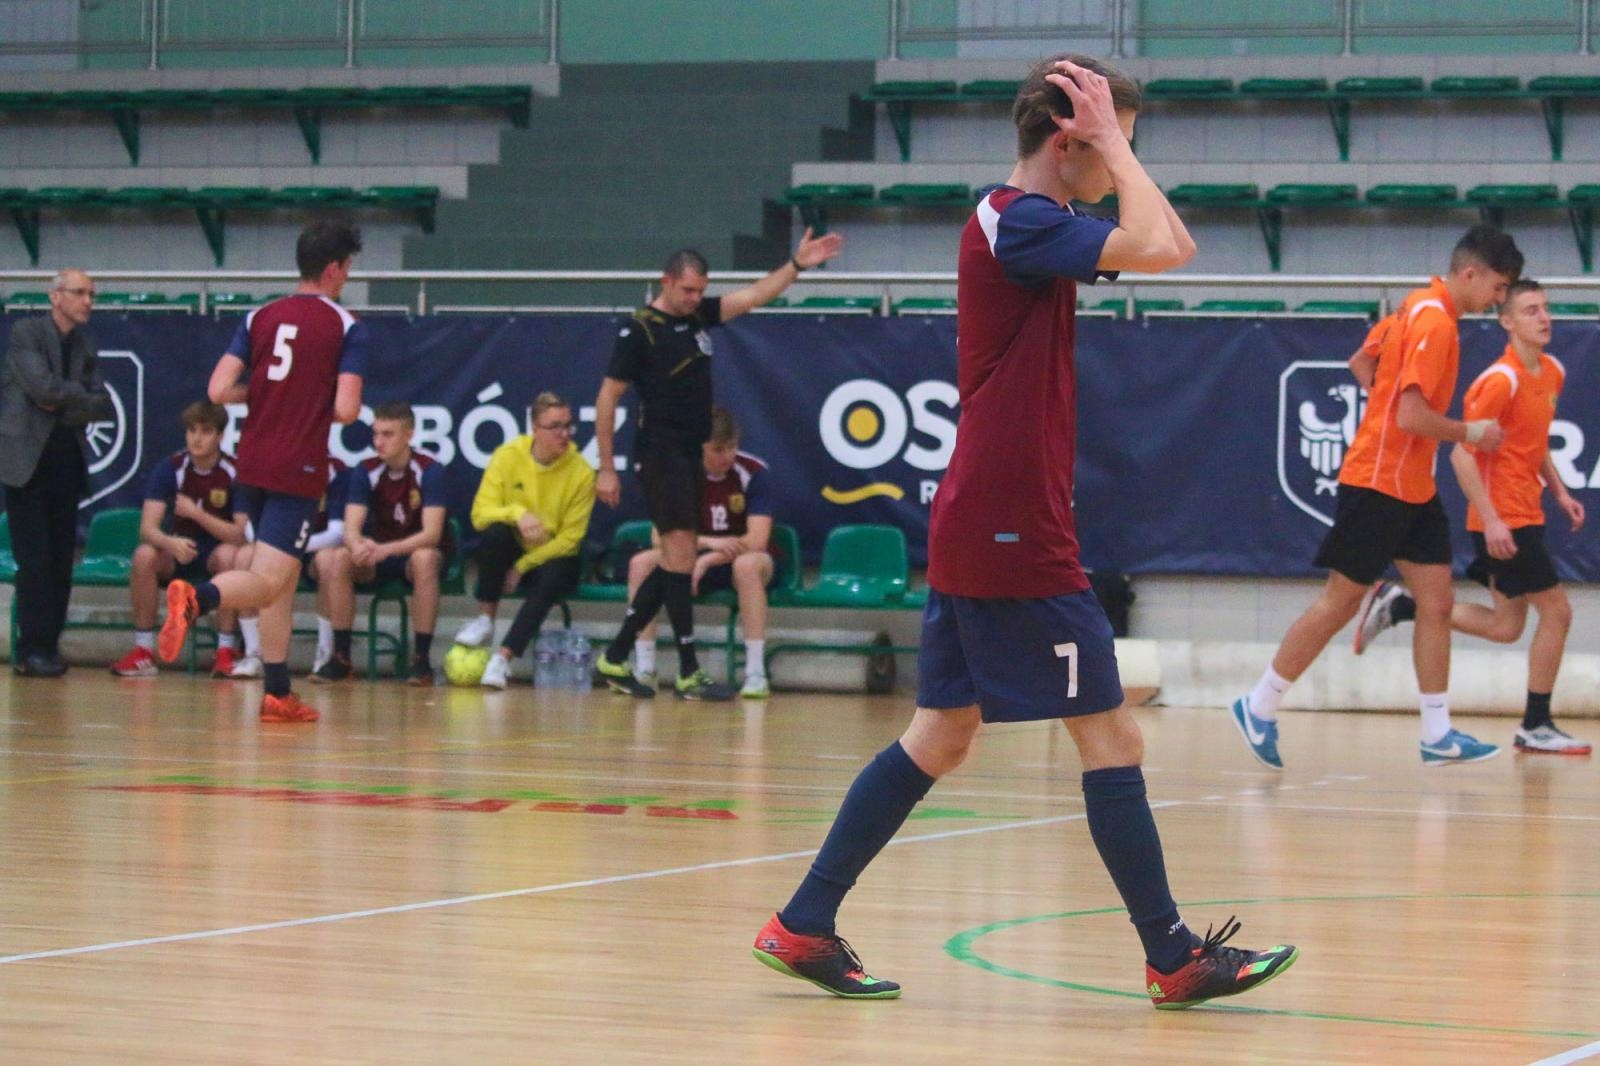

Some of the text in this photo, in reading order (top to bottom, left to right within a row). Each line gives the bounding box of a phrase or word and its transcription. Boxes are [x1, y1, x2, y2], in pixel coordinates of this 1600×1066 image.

[267, 323, 298, 381] 5
[819, 379, 960, 471] OS
[294, 520, 310, 549] 5
[393, 502, 406, 525] 4
[710, 504, 729, 531] 12
[1054, 642, 1078, 698] 7
